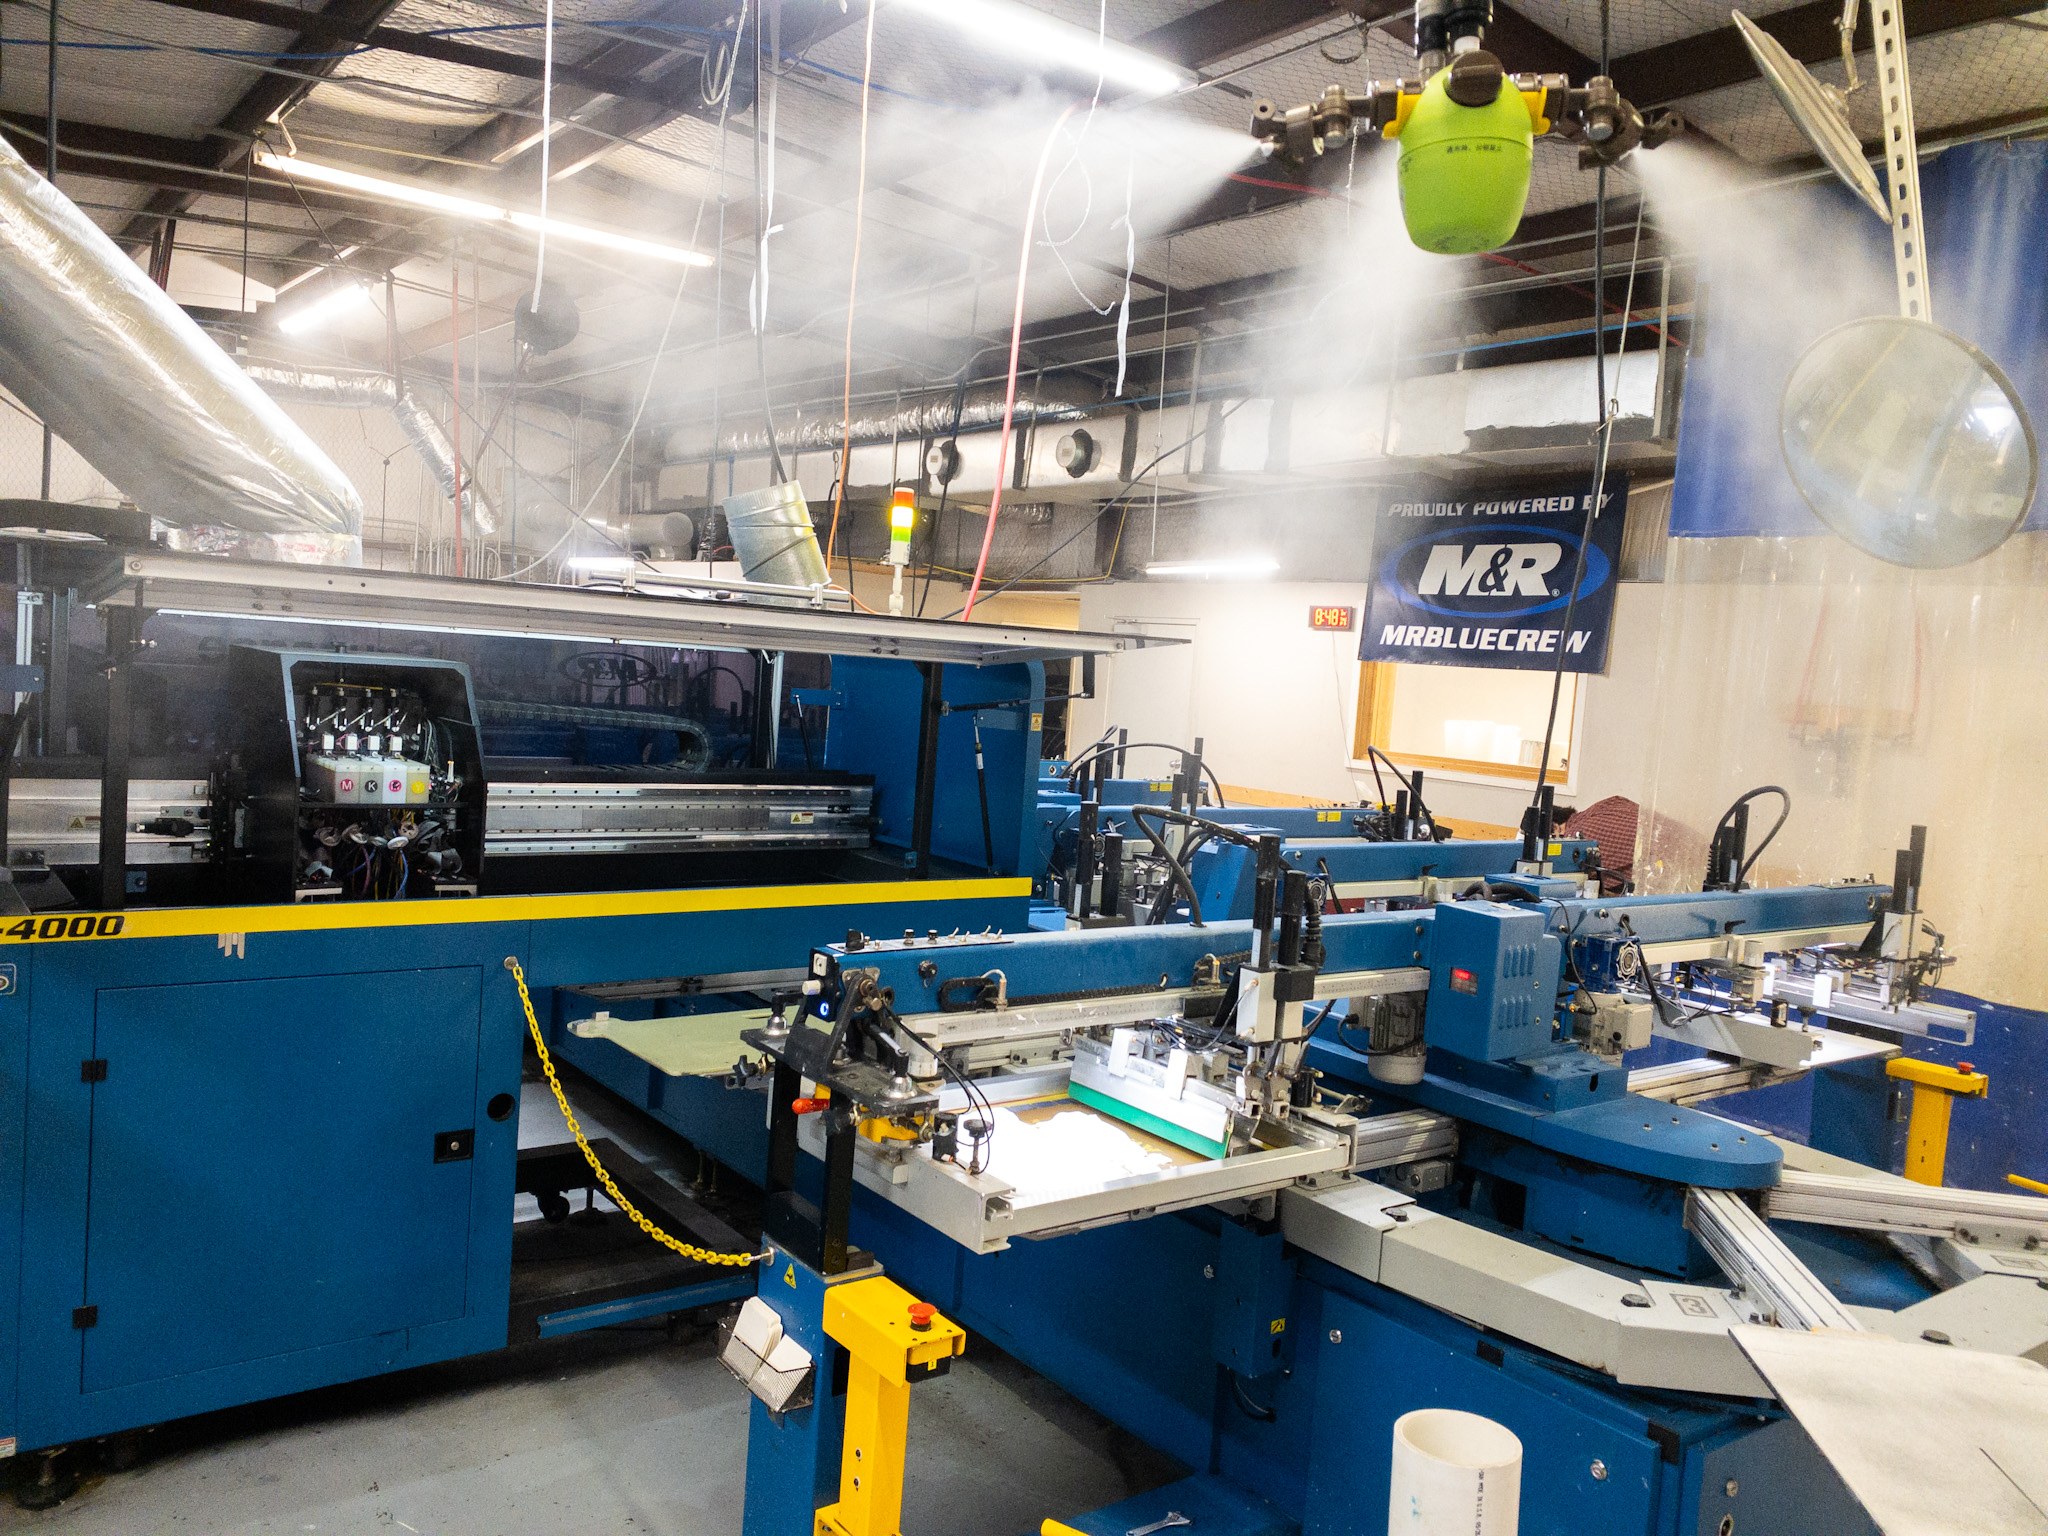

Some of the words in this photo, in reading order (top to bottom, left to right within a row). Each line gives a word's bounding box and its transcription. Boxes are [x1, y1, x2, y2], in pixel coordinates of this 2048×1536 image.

[1388, 501, 1468, 517] PROUDLY
[1473, 496, 1574, 516] POWERED
[1379, 625, 1591, 654] MRBLUECREW
[1682, 1298, 1707, 1314] 3
